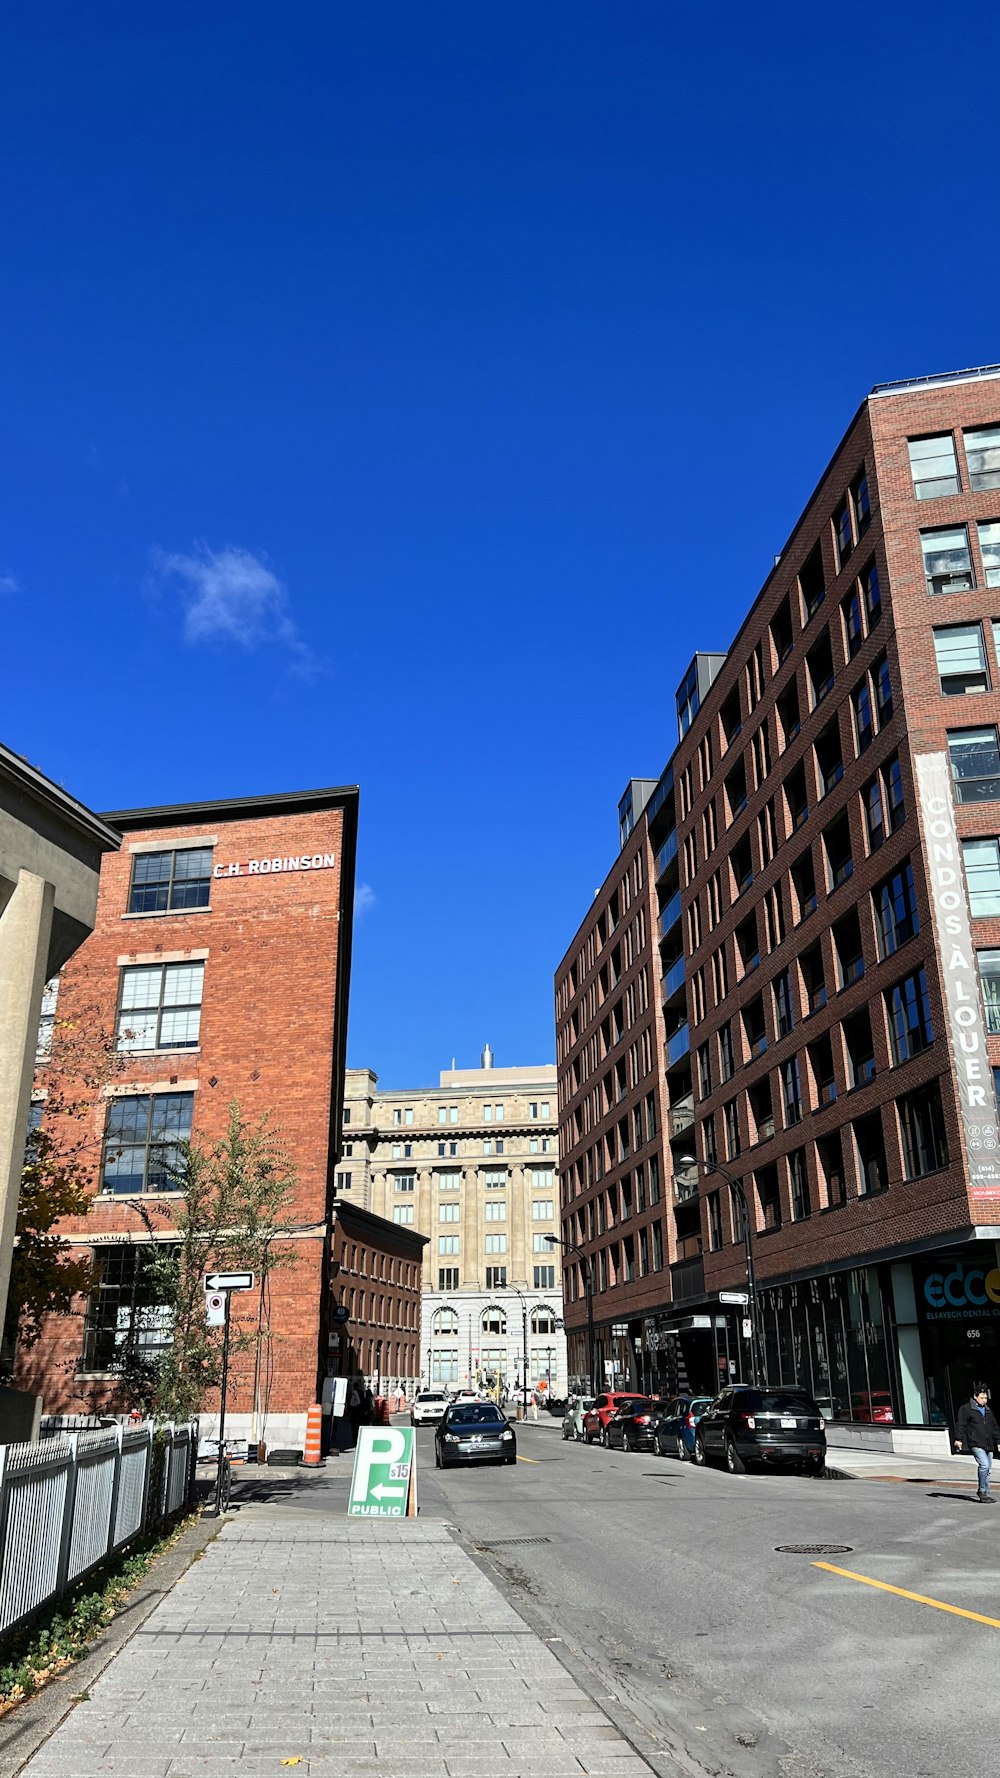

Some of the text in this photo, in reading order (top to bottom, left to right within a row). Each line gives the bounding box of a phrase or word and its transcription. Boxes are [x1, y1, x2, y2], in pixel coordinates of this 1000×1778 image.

[213, 853, 335, 878] C.H. ROBINSON
[927, 797, 962, 935] CONDOS
[948, 943, 970, 970] À
[954, 981, 987, 1107] LOUER
[963, 1309, 991, 1318] DENTAL
[966, 1329, 980, 1338] 656
[353, 1428, 405, 1502] P
[391, 1464, 409, 1478] $15
[352, 1505, 401, 1515] PUBLIC
